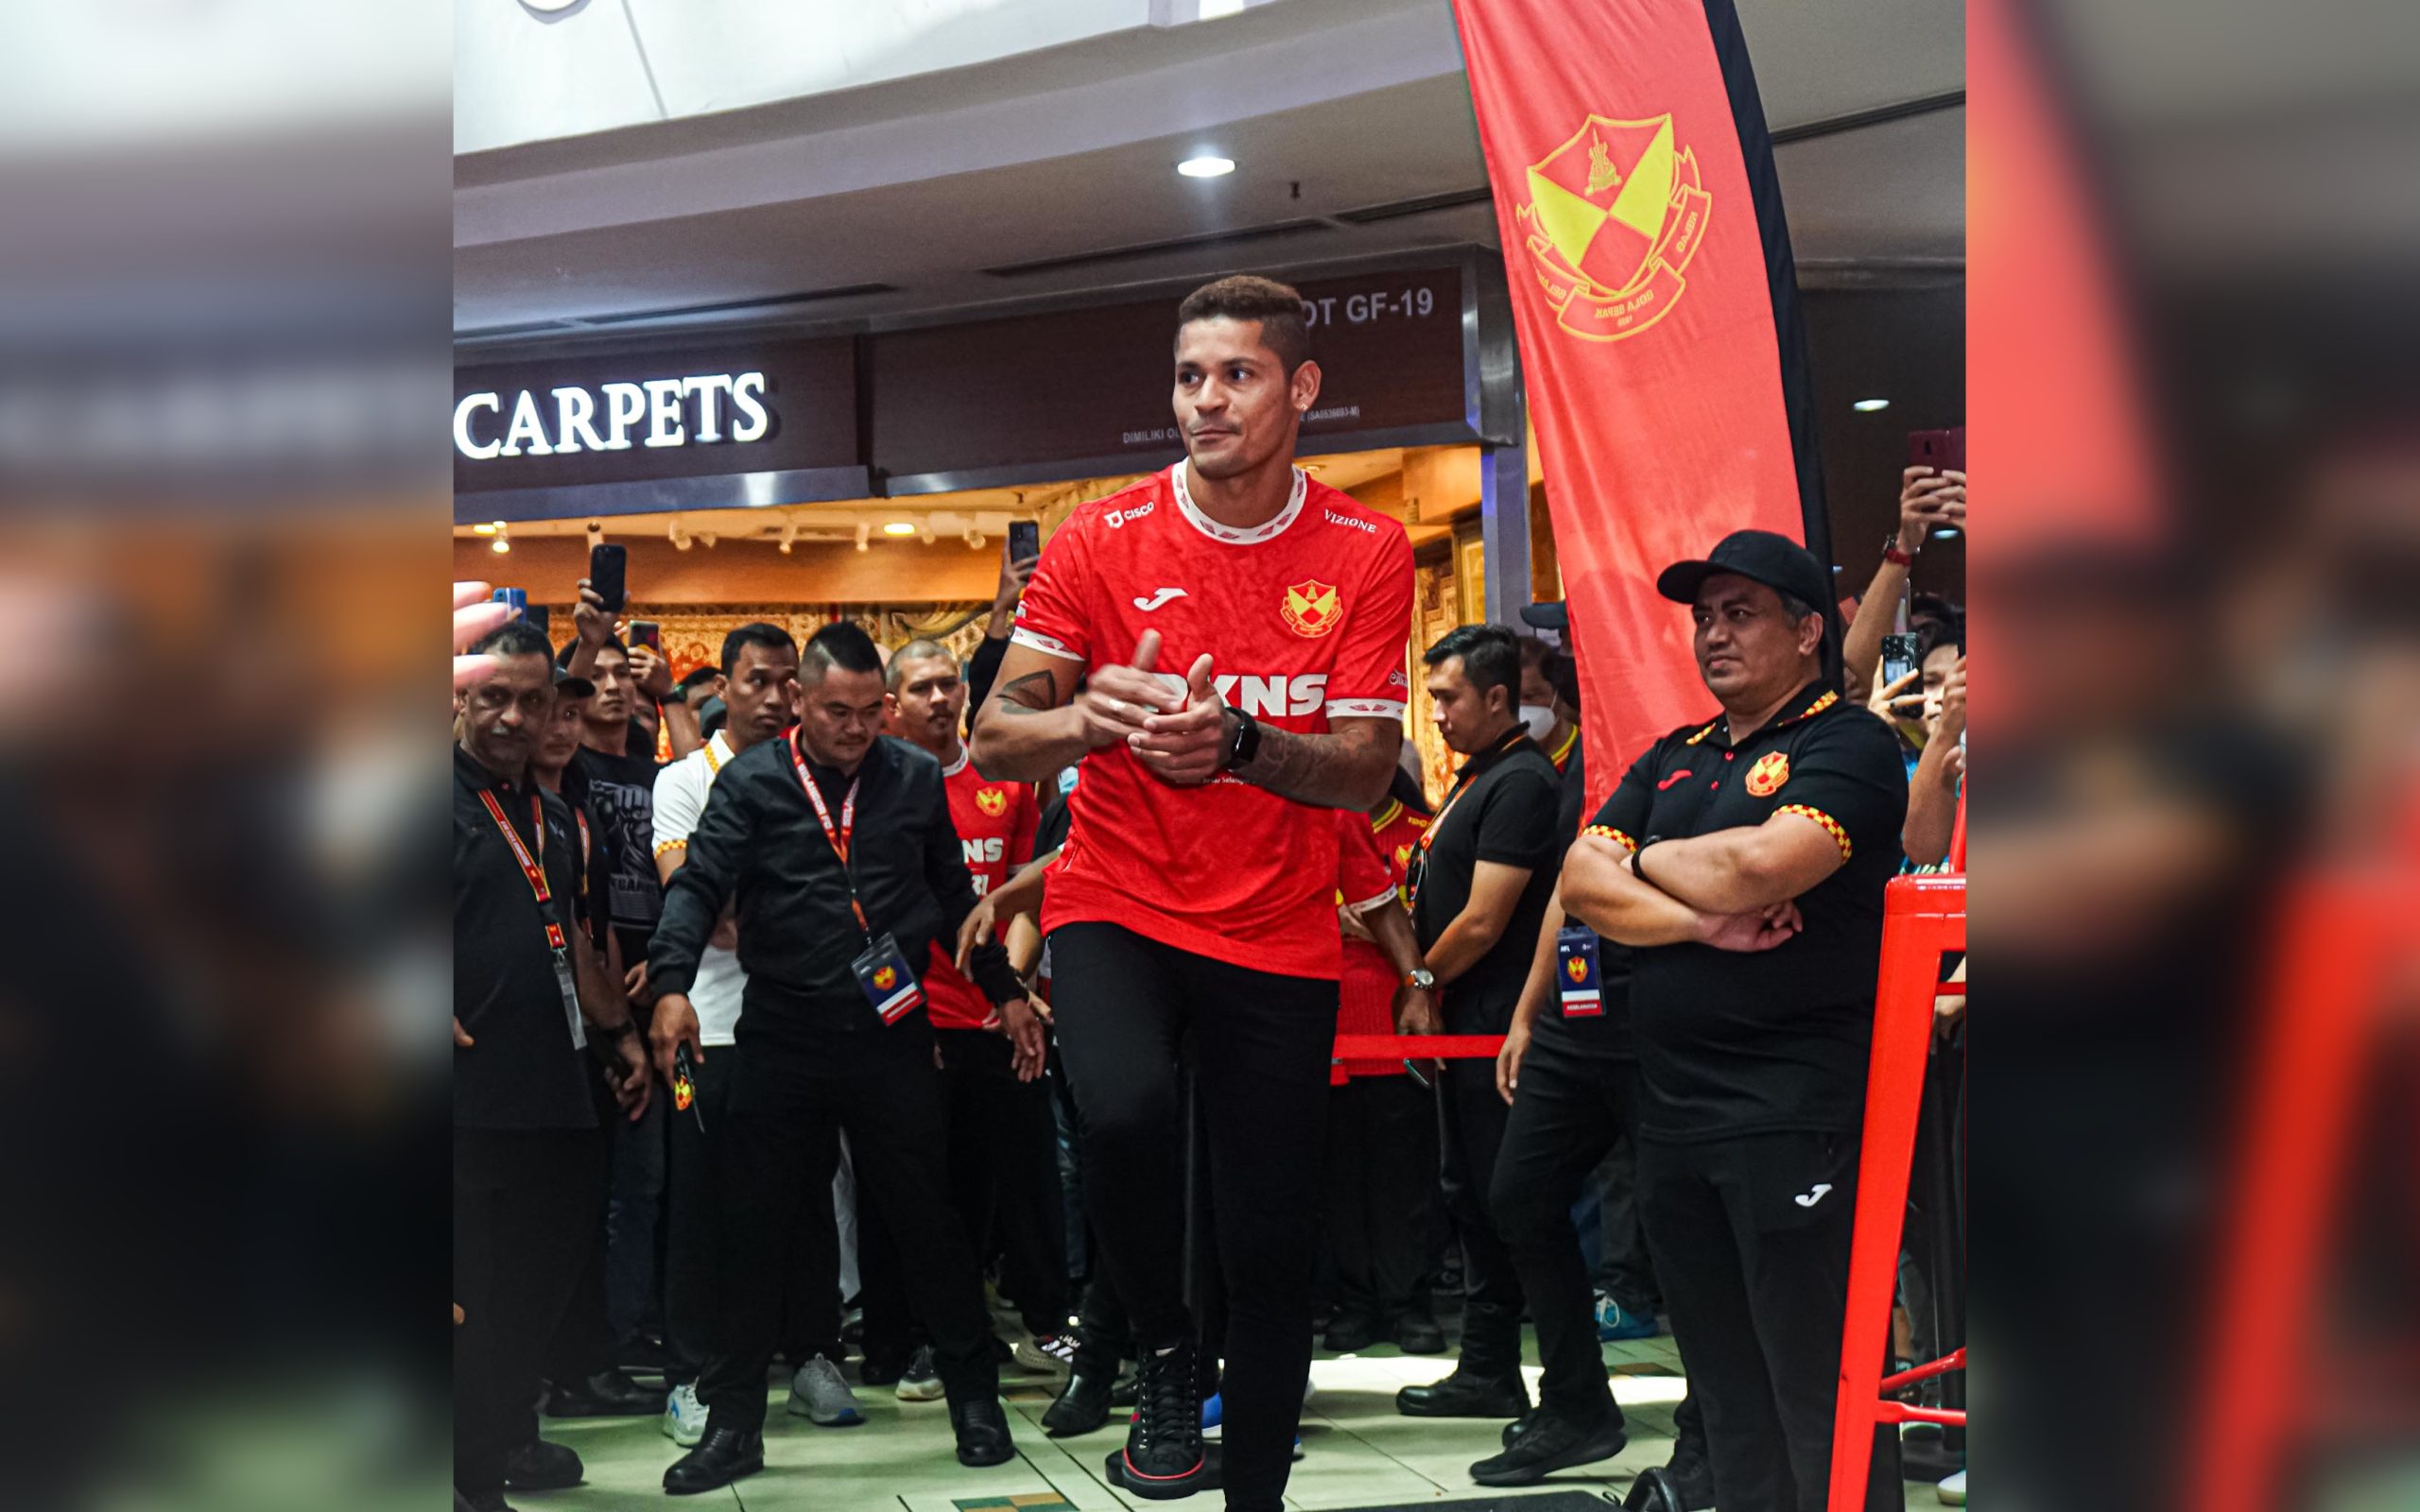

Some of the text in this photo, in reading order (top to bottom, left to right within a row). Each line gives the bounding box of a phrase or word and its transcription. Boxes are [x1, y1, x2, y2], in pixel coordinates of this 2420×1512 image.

[1346, 287, 1433, 322] GF-19
[453, 372, 768, 459] CARPETS
[1123, 428, 1164, 443] DIMILIKI
[1124, 502, 1154, 521] CISCO
[1324, 508, 1377, 533] VIZIONE
